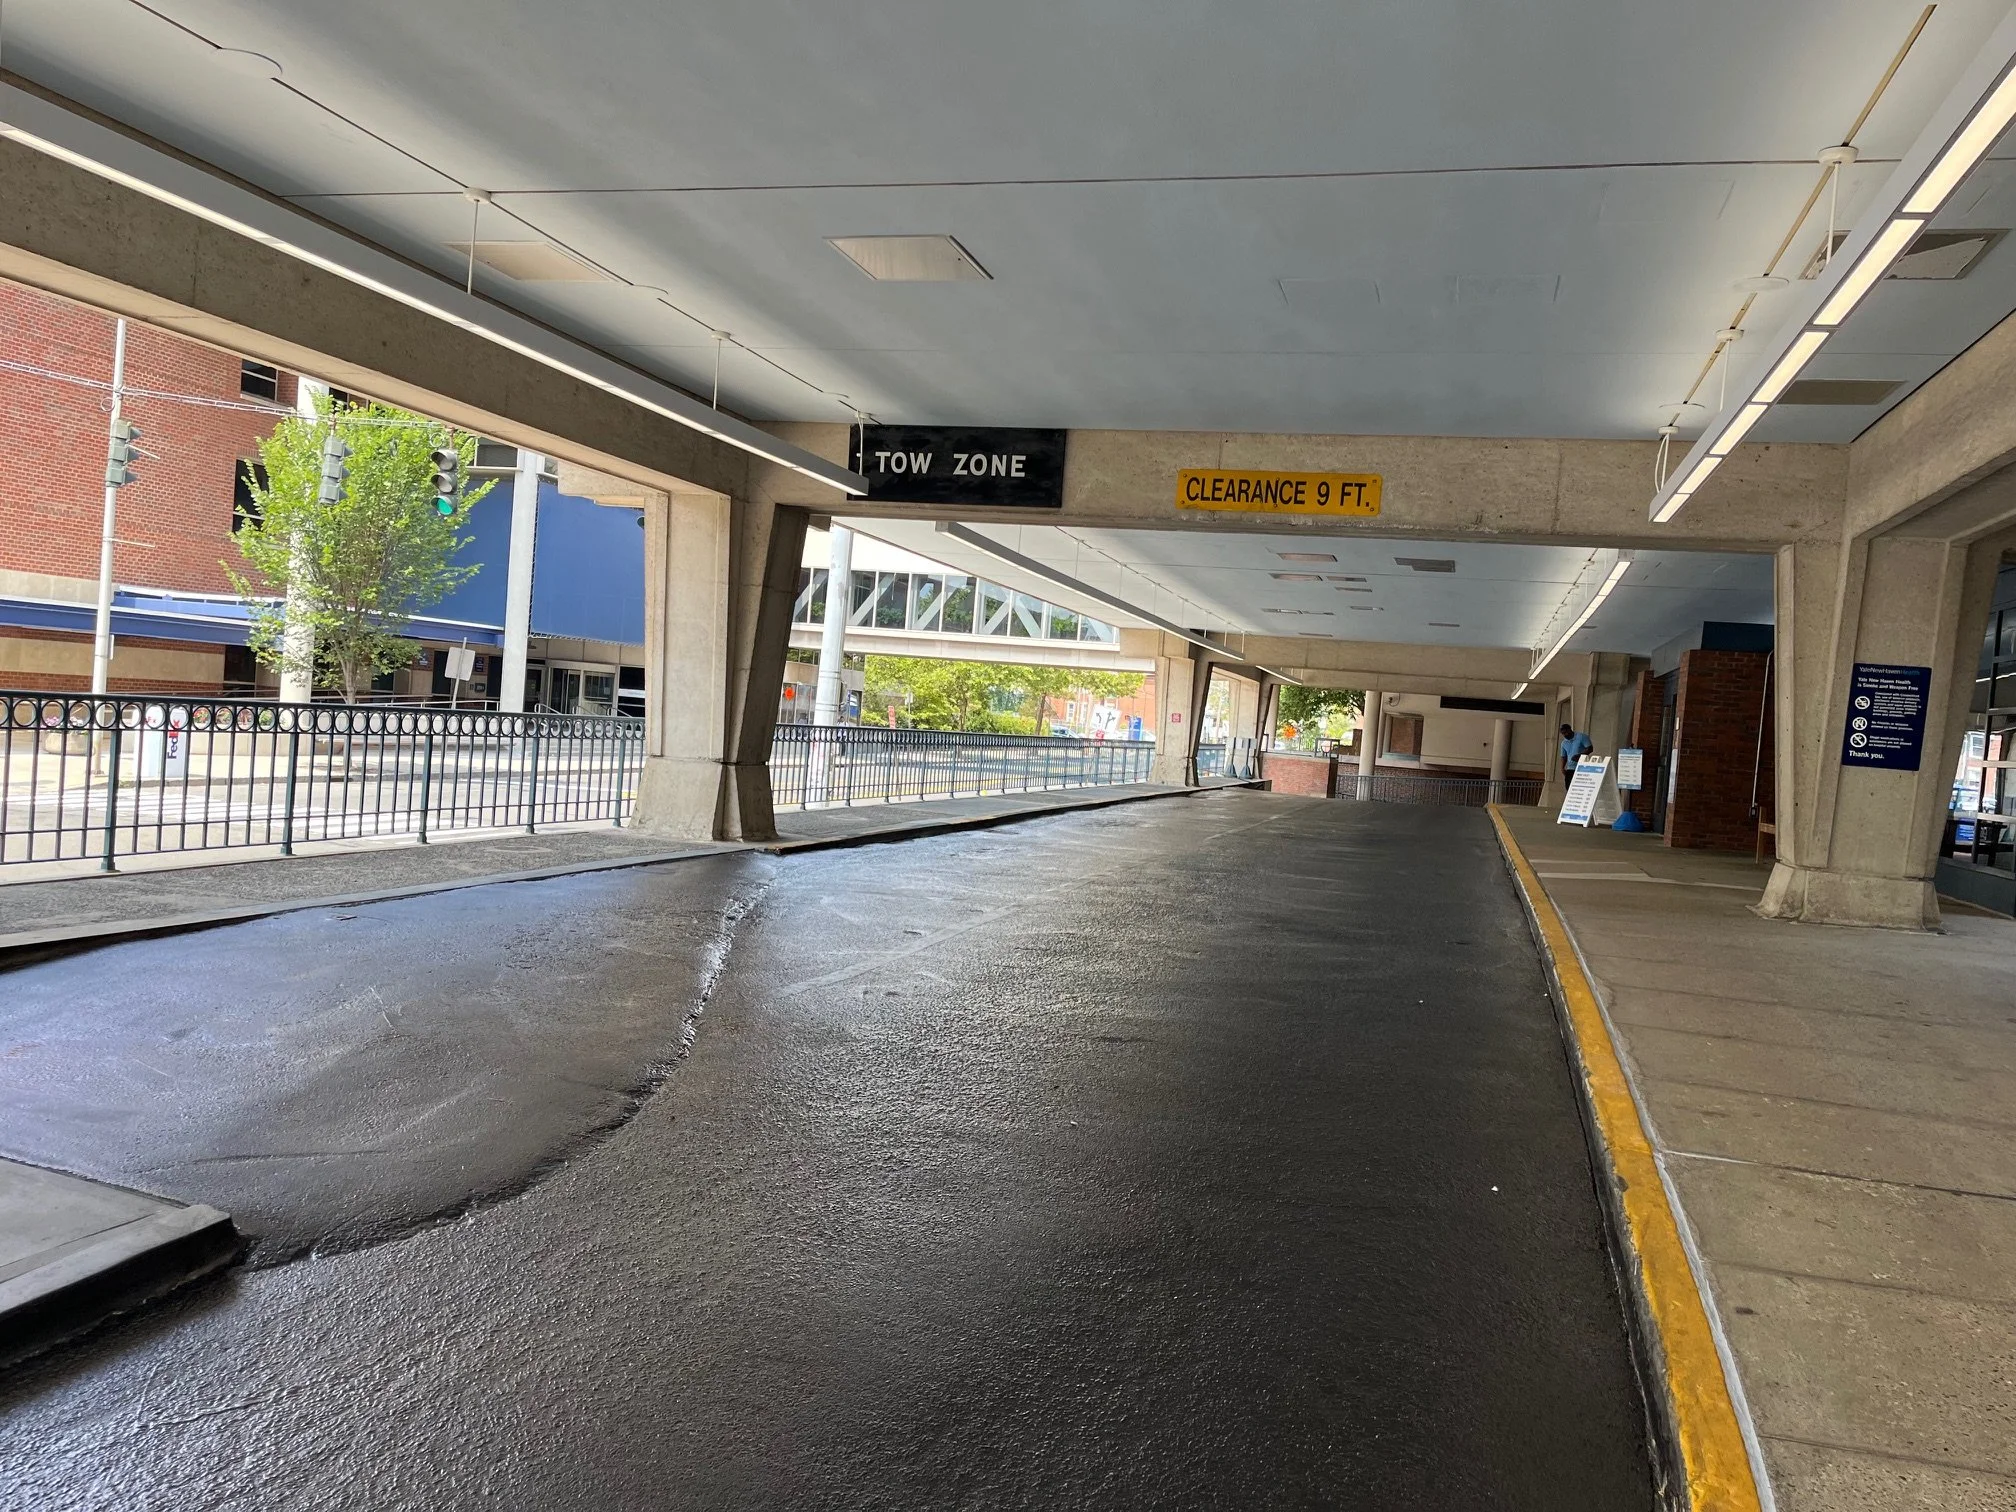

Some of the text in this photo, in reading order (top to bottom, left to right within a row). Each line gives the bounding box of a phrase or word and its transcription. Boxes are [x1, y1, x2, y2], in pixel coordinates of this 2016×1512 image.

[875, 451, 1027, 478] TOW ZONE
[1186, 477, 1370, 507] CLEARANCE 9 FT.
[1849, 749, 1885, 760] Thank you.
